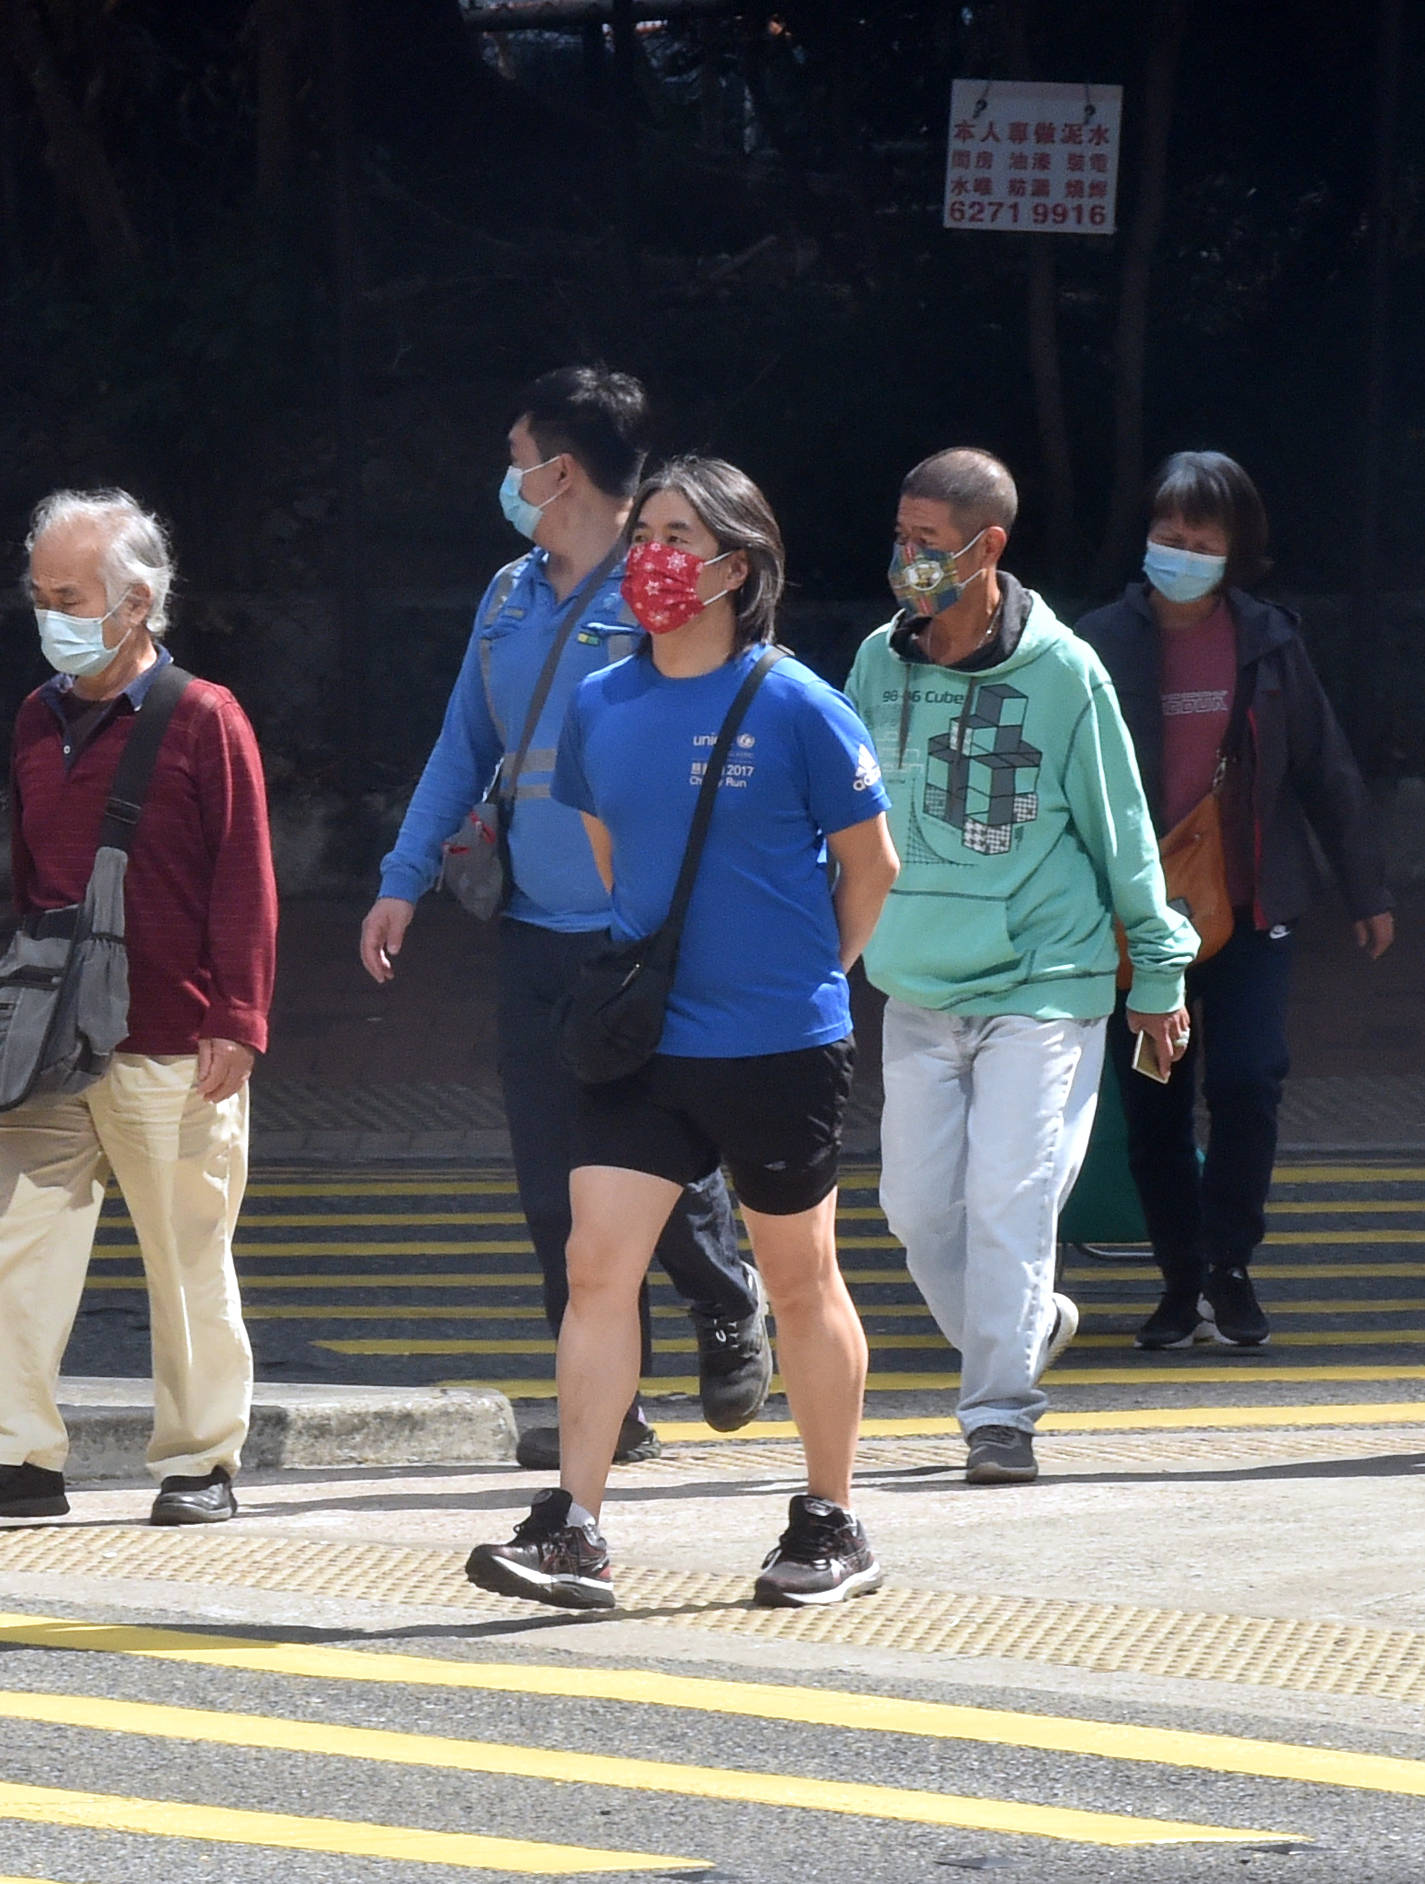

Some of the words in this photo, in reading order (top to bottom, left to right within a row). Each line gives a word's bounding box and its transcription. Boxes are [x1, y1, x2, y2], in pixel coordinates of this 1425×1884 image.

[954, 119, 1110, 146] 本人專做泥水
[949, 200, 1020, 223] 6271
[1032, 202, 1106, 225] 9916
[925, 690, 964, 705] Cube
[726, 763, 755, 777] 2017
[725, 776, 747, 788] Run
